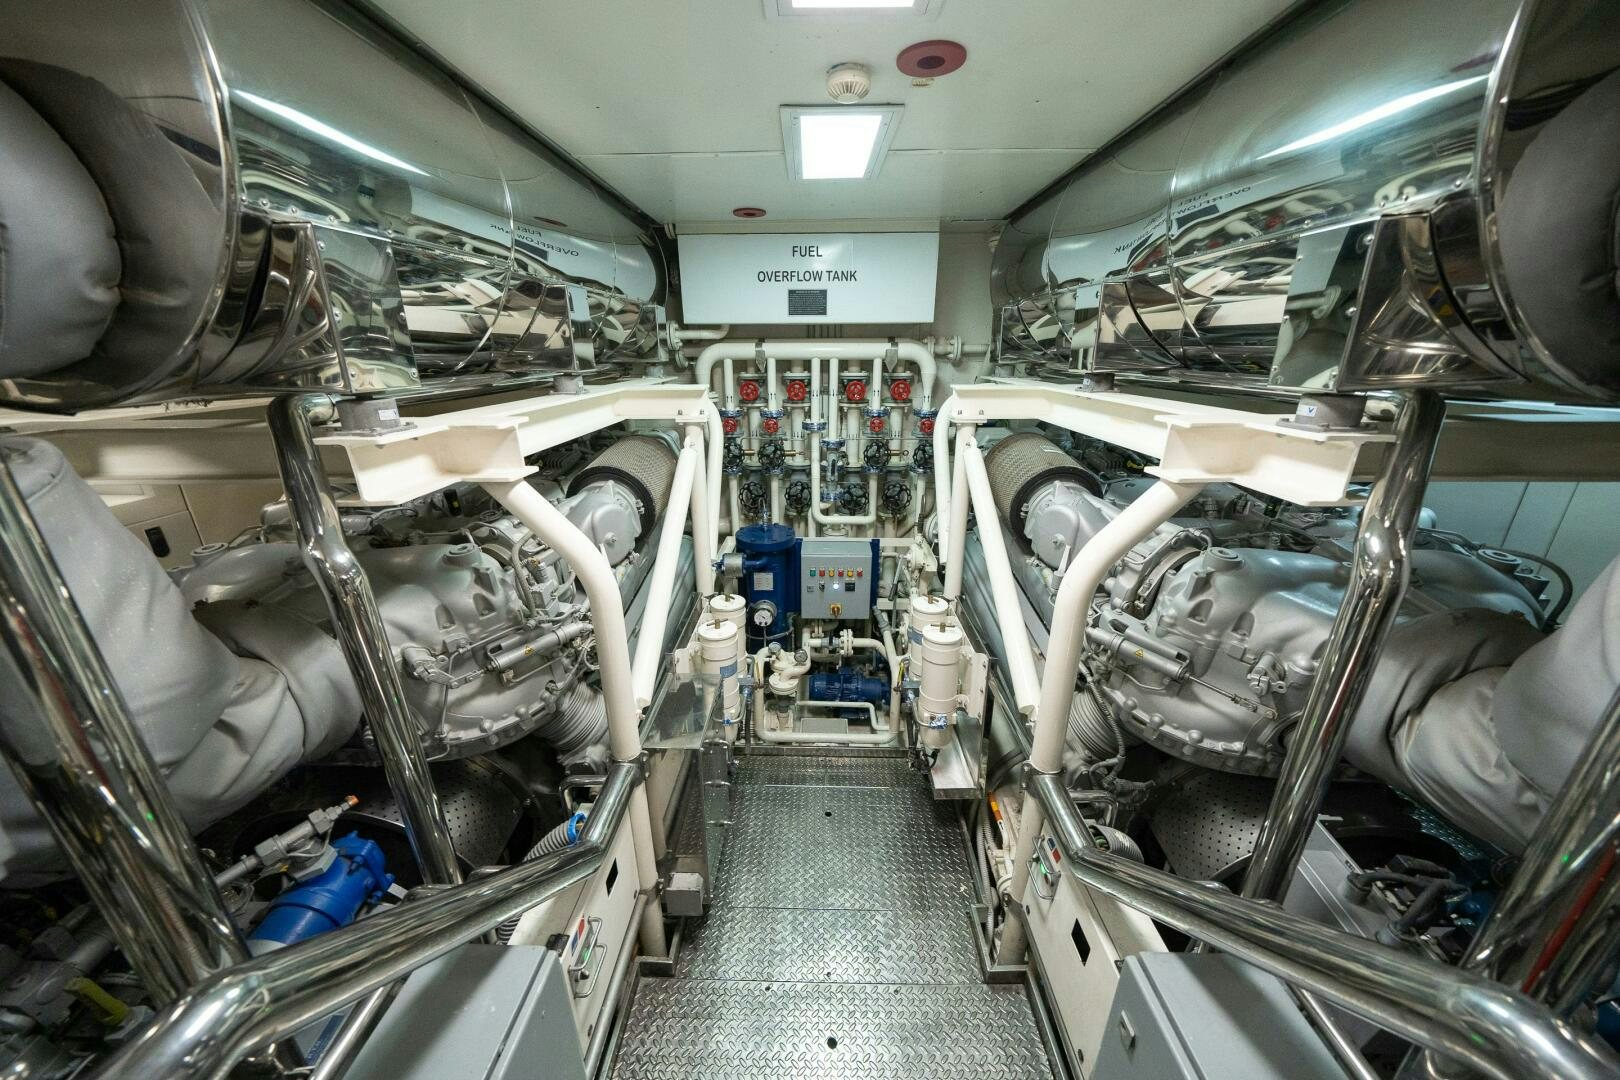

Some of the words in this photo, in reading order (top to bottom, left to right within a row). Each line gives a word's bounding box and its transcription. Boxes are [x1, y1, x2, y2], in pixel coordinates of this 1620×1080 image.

[792, 245, 823, 258] FUEL
[757, 270, 823, 283] OVERFLOW
[825, 270, 857, 282] TANK
